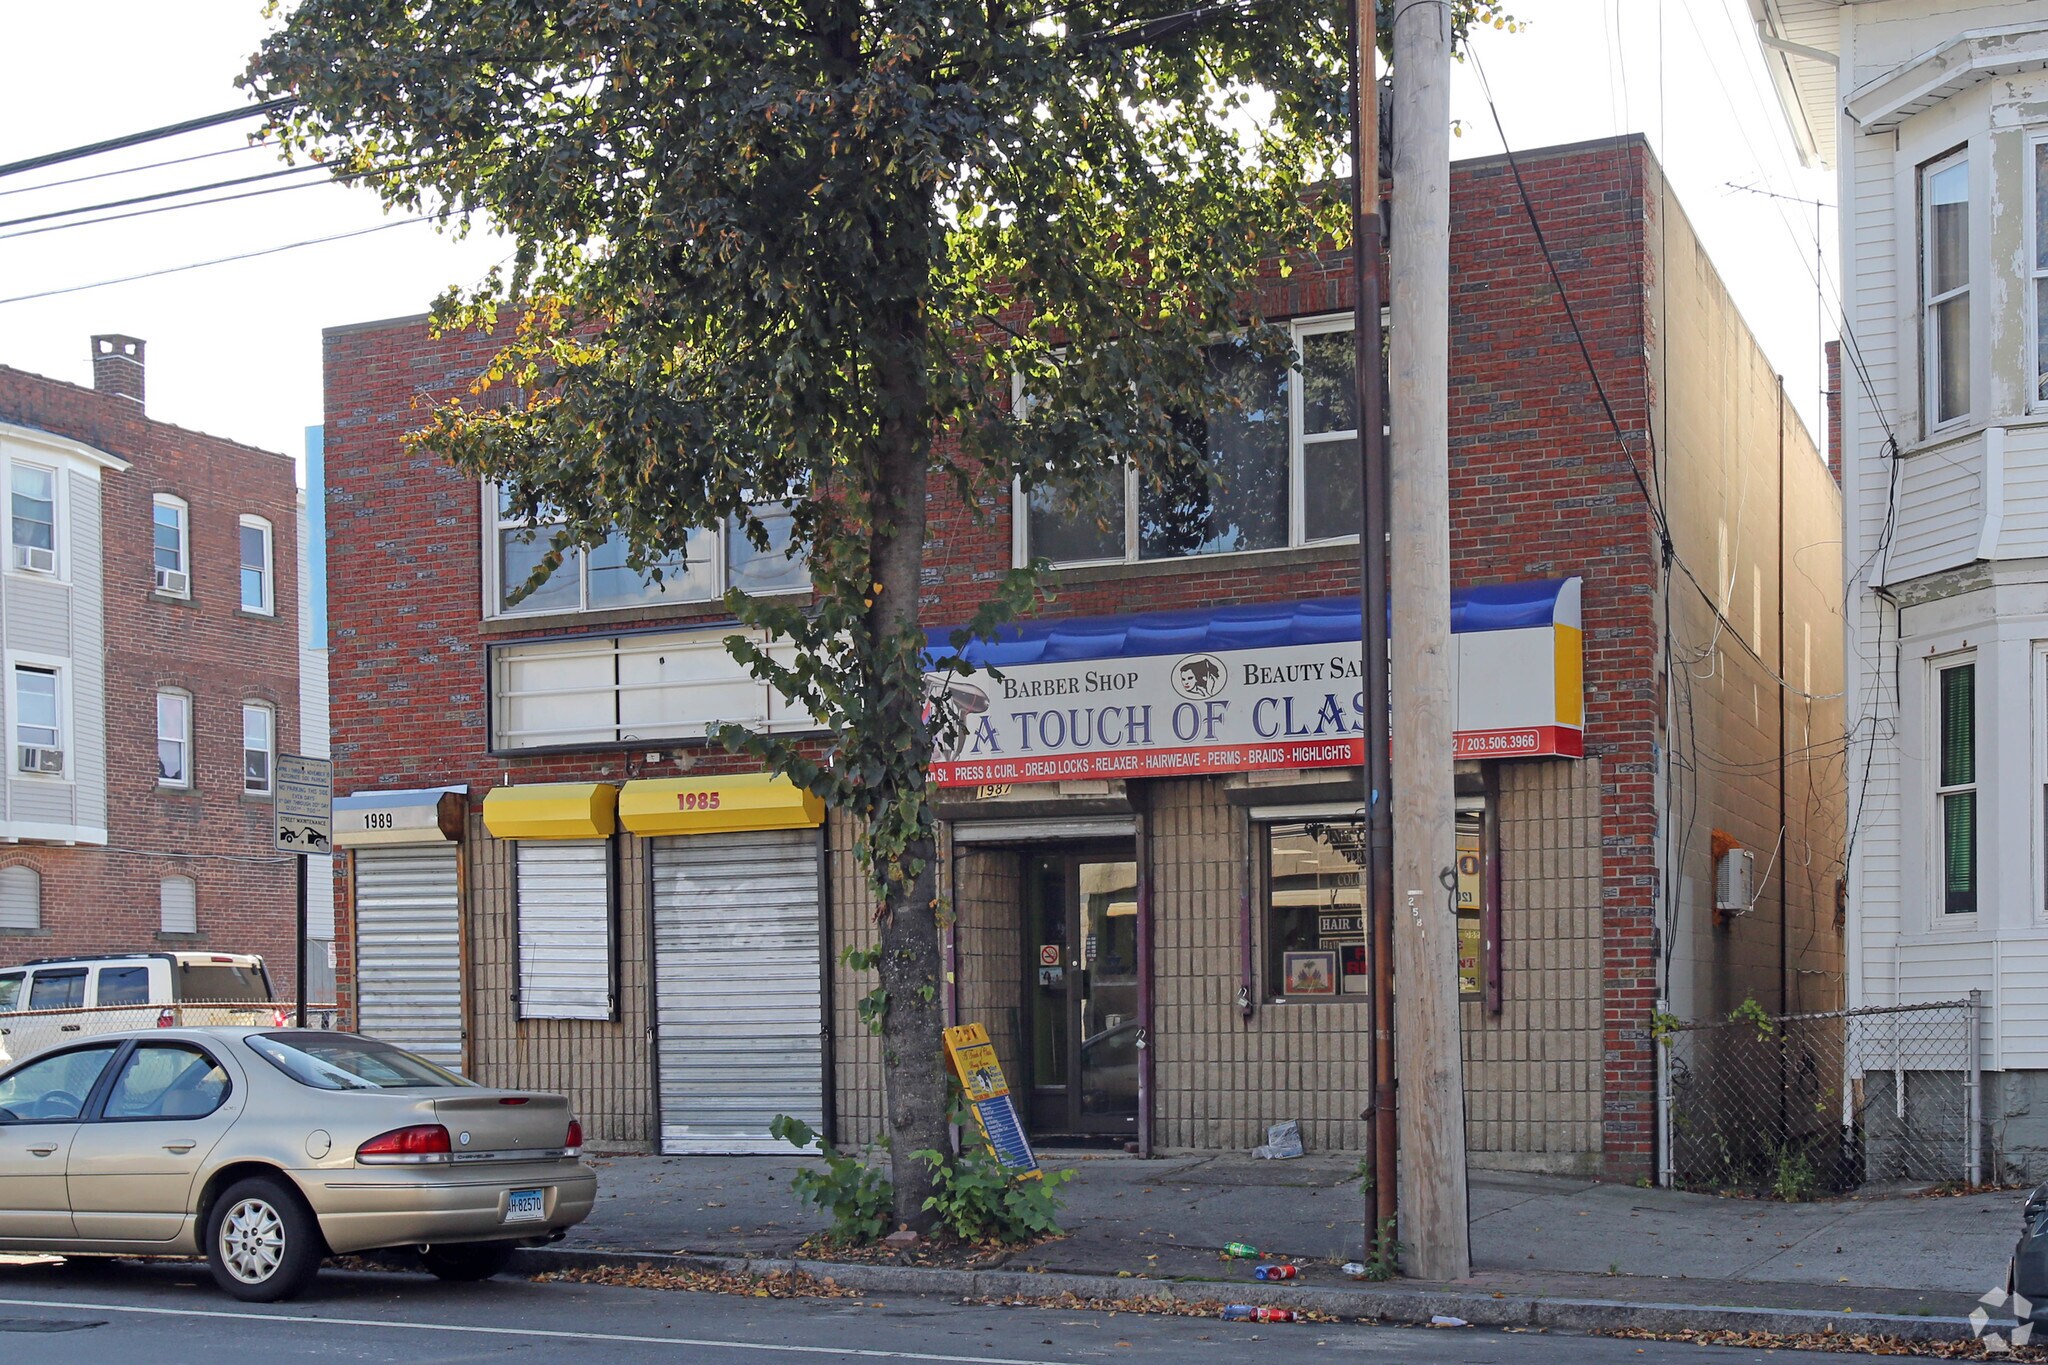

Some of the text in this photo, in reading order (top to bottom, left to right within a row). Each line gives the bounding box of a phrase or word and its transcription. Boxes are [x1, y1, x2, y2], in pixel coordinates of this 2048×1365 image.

[1243, 663, 1325, 685] BEAUTY
[1003, 671, 1138, 699] BARBER SHOP
[970, 715, 1003, 755] A
[1011, 704, 1155, 752] TOUCH
[1172, 699, 1230, 743] OF
[1467, 734, 1535, 751] 203.506.3966
[955, 766, 984, 781] PRESS
[994, 764, 1018, 778] CURL
[1026, 761, 1056, 777] DREAD
[1058, 758, 1089, 774] LOCKS
[1096, 755, 1138, 771] RELAXER
[1146, 752, 1200, 768] HAIRWEAVE
[1208, 749, 1241, 766] PERMS
[1249, 747, 1285, 763] BRAIDS
[1292, 744, 1351, 761] HIGHLIGHTS
[286, 785, 307, 793] PARKING
[677, 791, 720, 811] 1985
[296, 818, 327, 826] MAINTENANCE
[364, 813, 393, 829] 1989
[1322, 918, 1351, 930] HAIR
